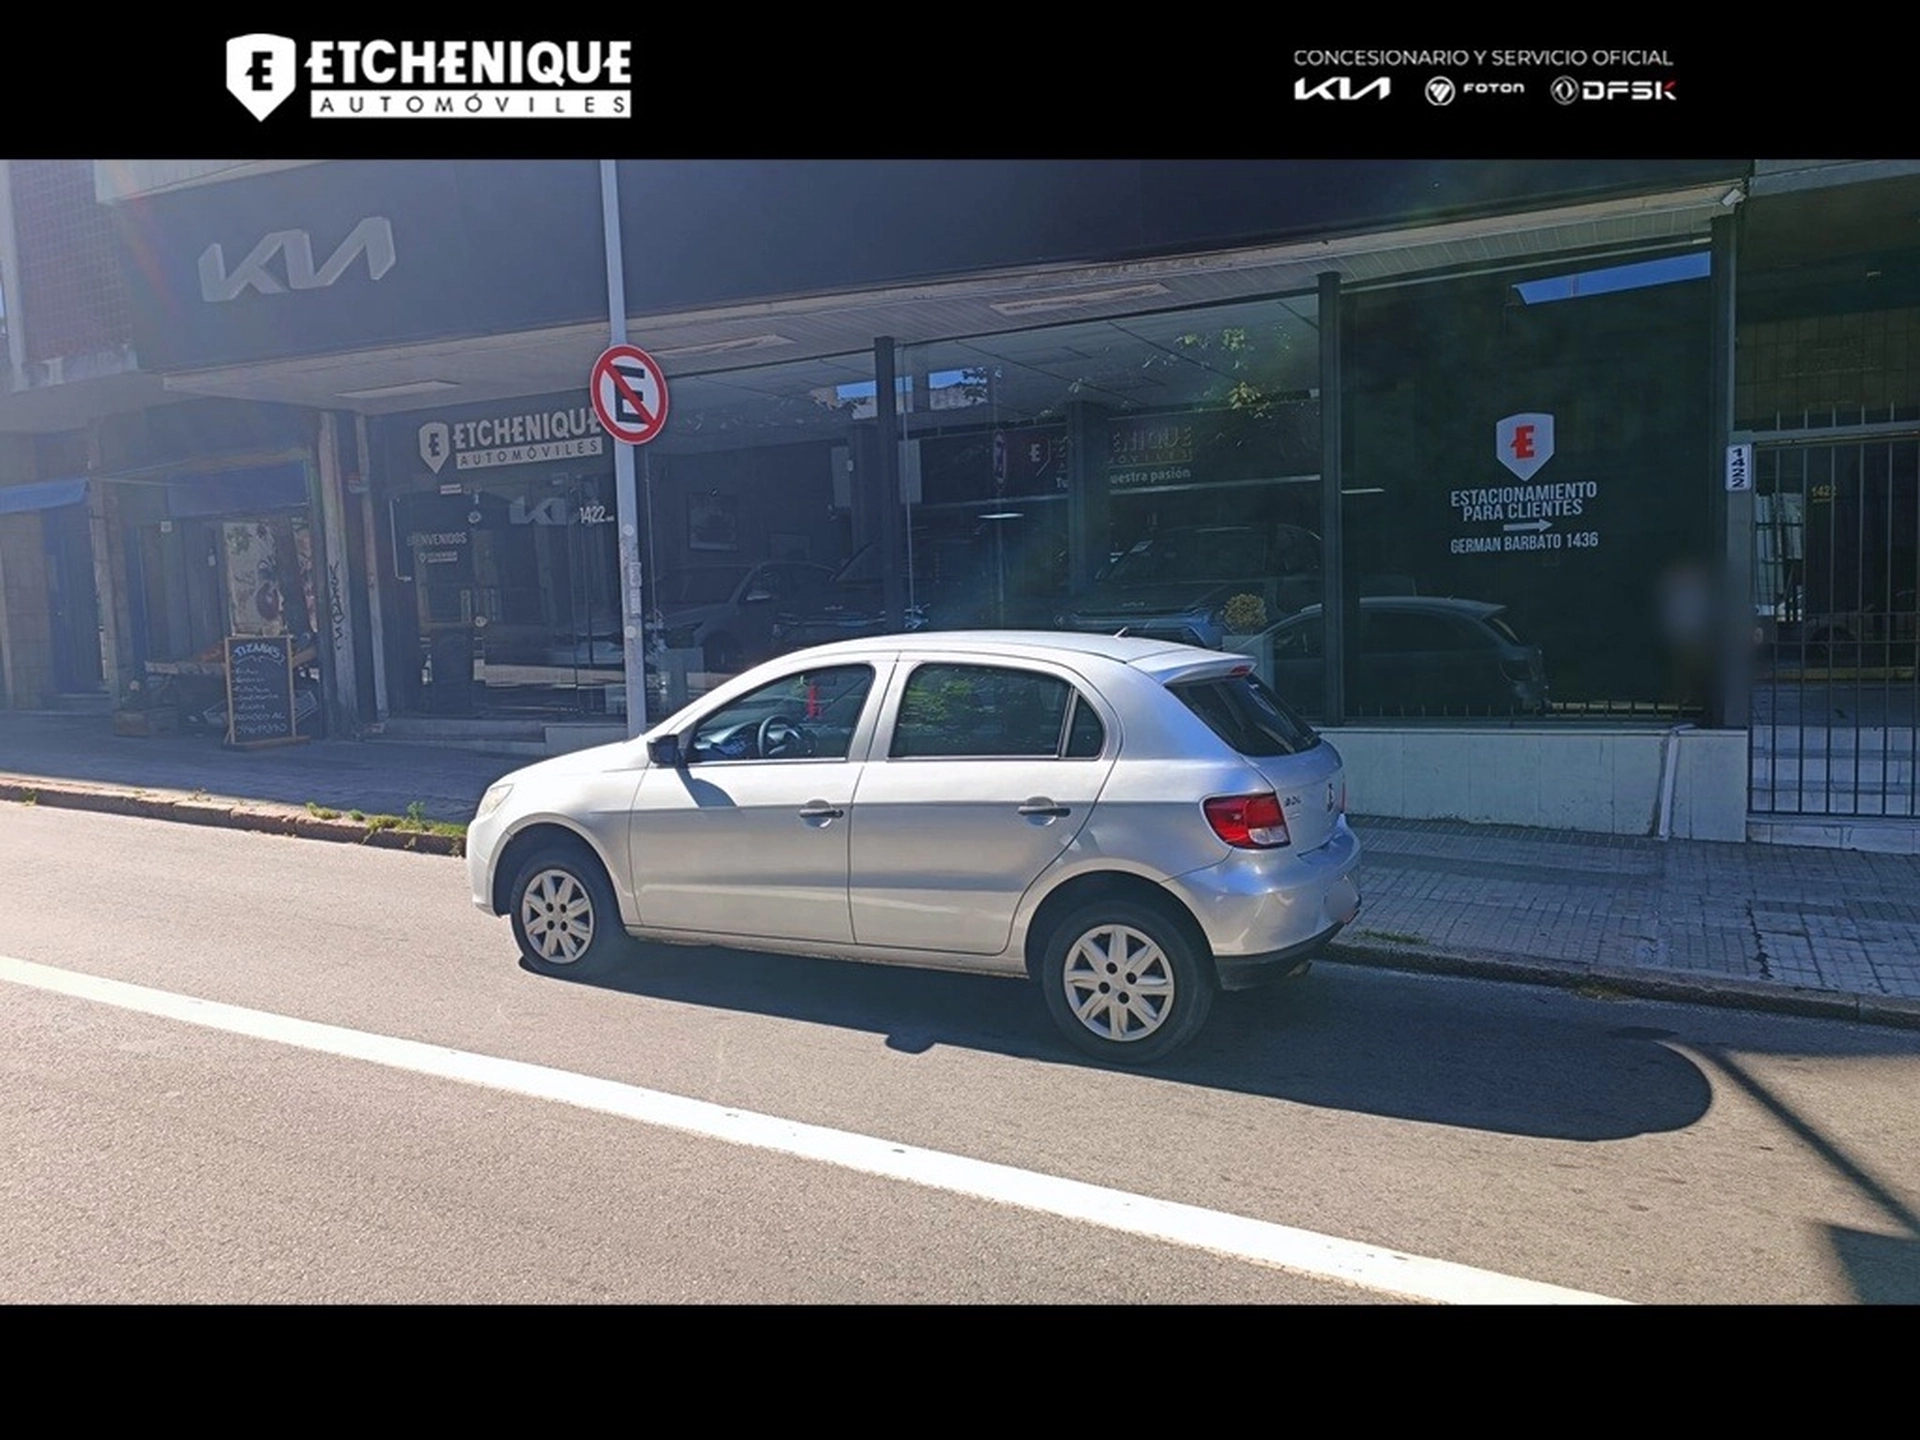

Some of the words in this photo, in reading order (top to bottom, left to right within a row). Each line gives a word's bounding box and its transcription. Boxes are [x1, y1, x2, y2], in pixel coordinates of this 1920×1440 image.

[198, 216, 396, 302] KIA
[614, 365, 654, 424] E
[453, 407, 601, 449] ETCHENIQUE
[460, 440, 598, 466] AUTOMÓVILES
[1110, 472, 1148, 484] uestra
[1731, 448, 1745, 489] 1422
[1451, 481, 1597, 507] ESTACIONAMIENTO
[579, 505, 606, 524] 1422
[1463, 504, 1504, 522] PARA
[1508, 499, 1583, 519] CLIENTES
[1451, 537, 1501, 554] GERMAN
[1504, 533, 1562, 551] BARBATO
[1567, 531, 1599, 548] 1436
